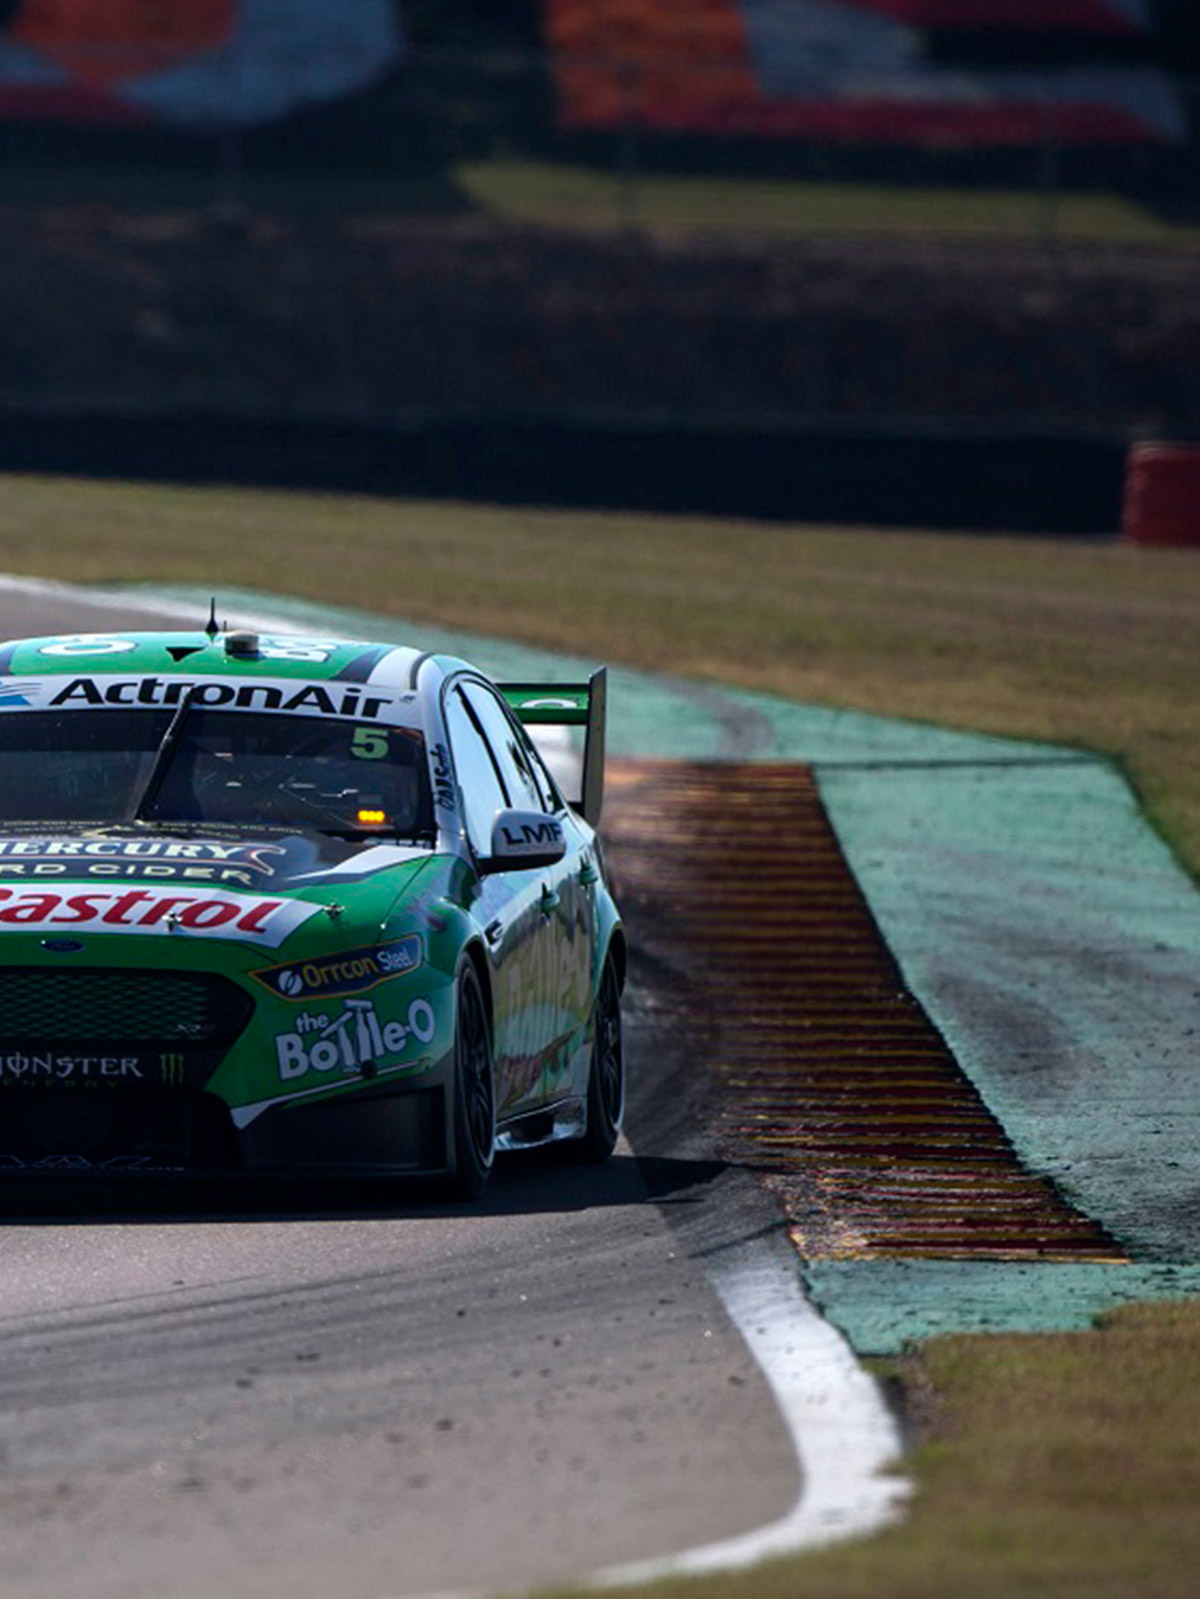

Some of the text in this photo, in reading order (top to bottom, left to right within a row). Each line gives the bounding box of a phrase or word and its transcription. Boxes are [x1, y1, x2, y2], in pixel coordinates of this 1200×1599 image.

[48, 677, 394, 719] ActronAir
[351, 727, 391, 760] 5
[501, 822, 562, 846] LMF
[88, 863, 253, 885] CIDER
[302, 946, 414, 988] Orrcon Steel
[295, 1011, 329, 1034] the
